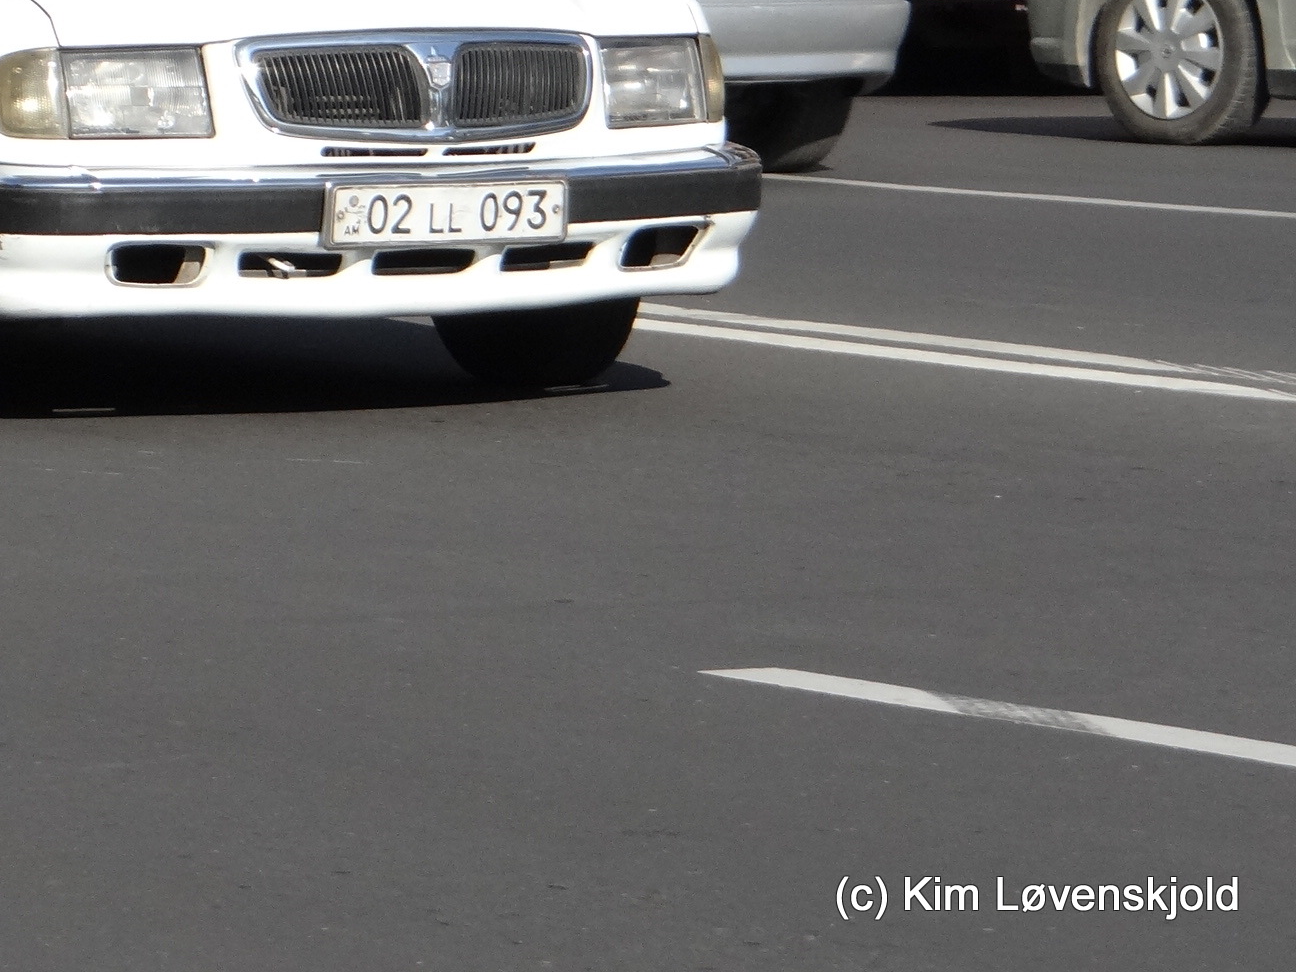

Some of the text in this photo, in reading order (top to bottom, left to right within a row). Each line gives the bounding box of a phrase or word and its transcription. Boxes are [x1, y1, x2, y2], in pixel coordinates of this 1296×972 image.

[367, 189, 547, 234] 02 LL 093
[344, 225, 360, 236] AM
